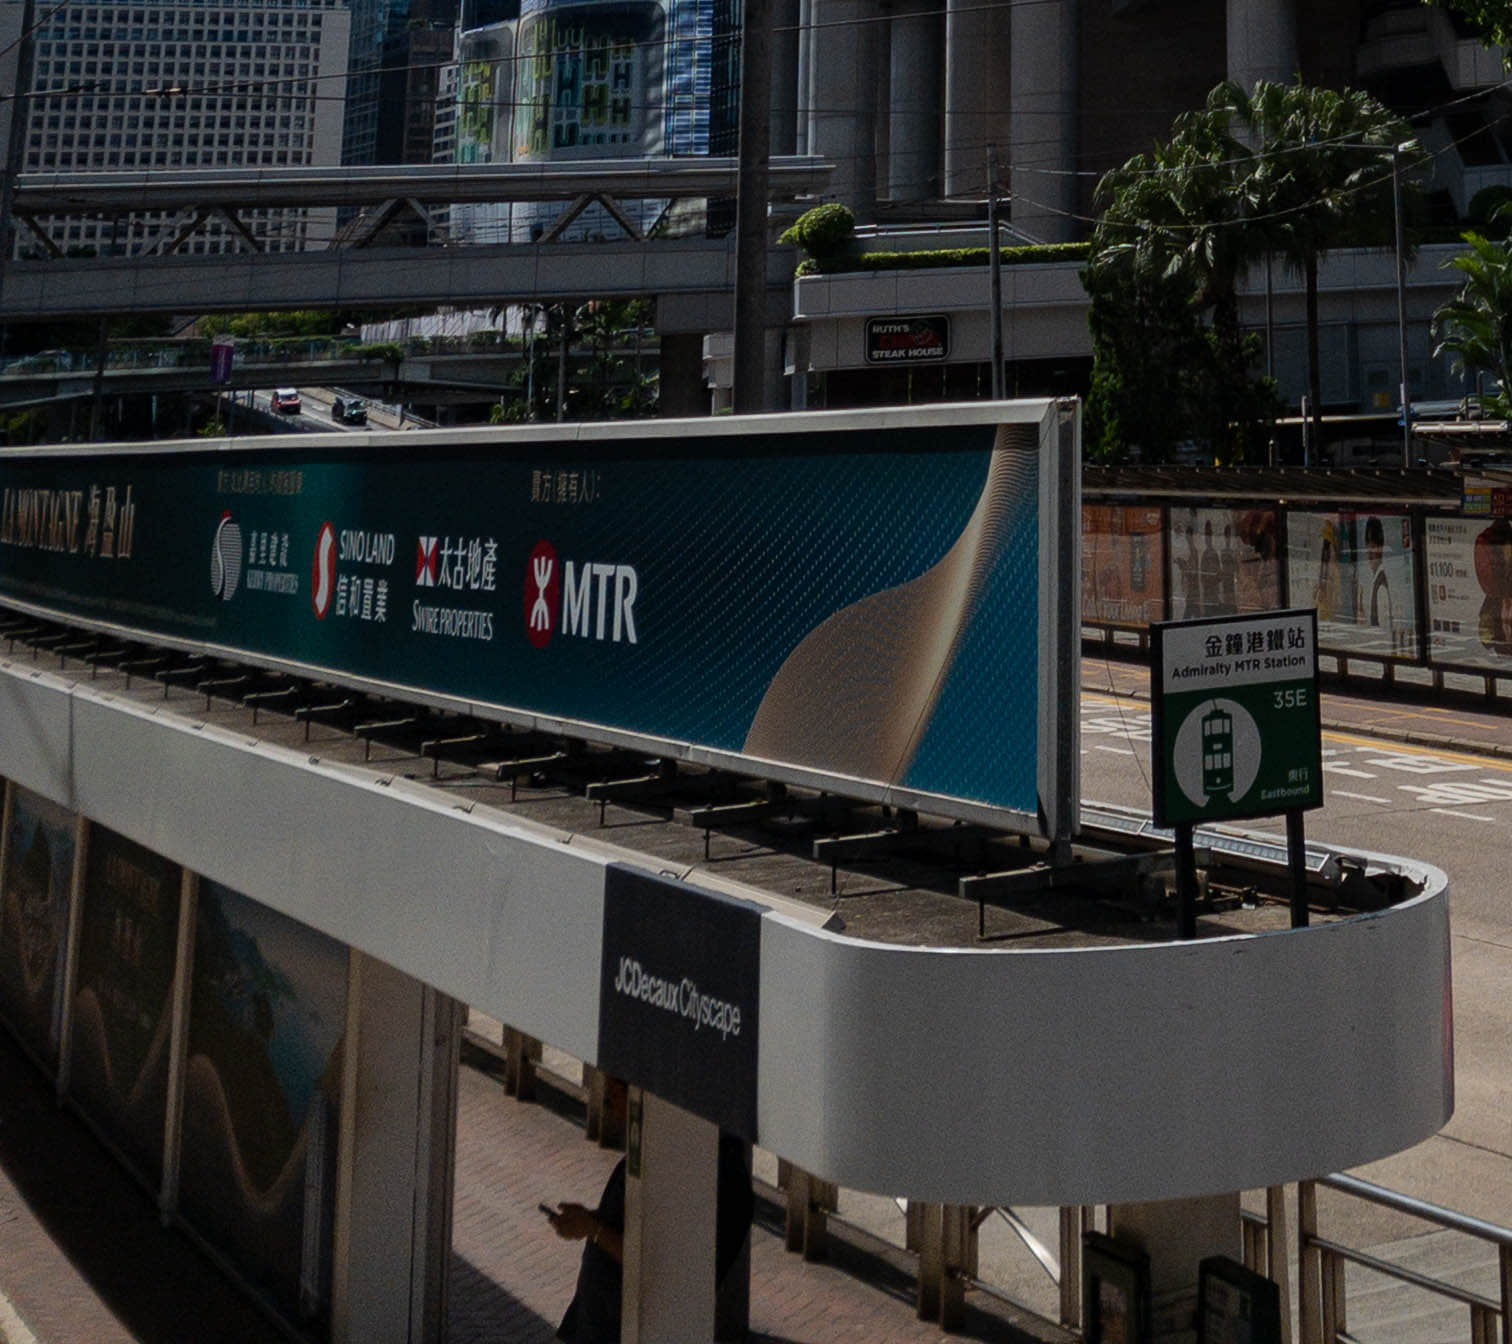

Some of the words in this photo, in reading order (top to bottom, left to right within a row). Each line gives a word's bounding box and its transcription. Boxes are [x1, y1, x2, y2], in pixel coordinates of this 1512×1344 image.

[871, 349, 906, 360] STEAK
[908, 347, 944, 358] HOUSE
[339, 529, 365, 562] SINO
[365, 533, 395, 566] LAND
[438, 537, 498, 591] 太古地產
[561, 561, 638, 645] MTR
[439, 609, 494, 641] PROPERTIES
[1205, 627, 1305, 659] 金鐘港鐵站
[1172, 662, 1231, 681] Admiralty
[1235, 659, 1260, 673] MTR
[1264, 655, 1306, 670] Station
[1274, 689, 1308, 709] 35E
[1288, 768, 1309, 782] 東行
[1261, 785, 1310, 800] Eastbound
[615, 956, 680, 1012] JCDecaux
[680, 977, 741, 1041] Cityscape
